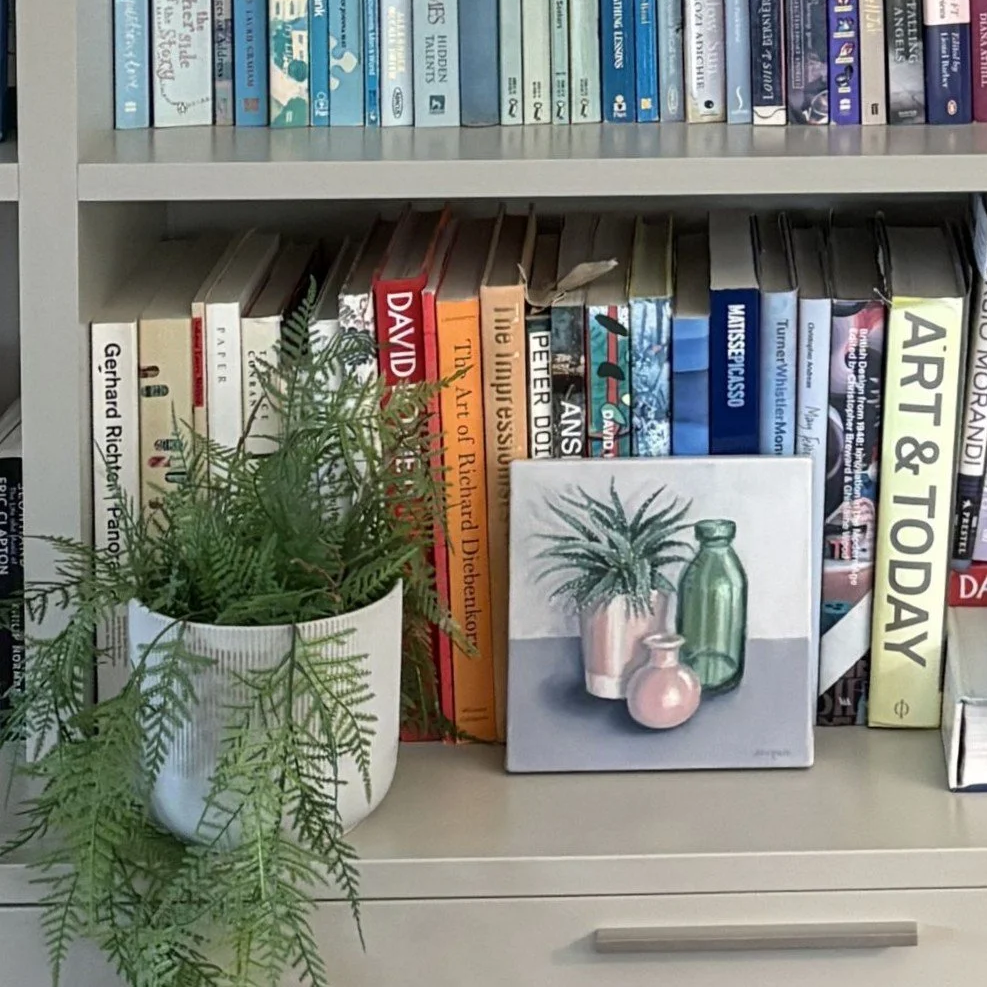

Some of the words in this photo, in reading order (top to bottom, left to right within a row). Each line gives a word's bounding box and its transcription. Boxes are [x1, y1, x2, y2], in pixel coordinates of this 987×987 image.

[425, 35, 435, 84] TALENTS
[437, 35, 448, 83] HIDDEN
[613, 32, 624, 69] LESSONS
[695, 33, 704, 89] ADICHIE
[386, 291, 417, 377] DAVID
[103, 342, 121, 419] Gerhard
[532, 335, 551, 407] PETER
[897, 312, 949, 429] ART
[104, 426, 122, 485] Richter
[893, 436, 940, 476] &
[884, 485, 937, 668] TODAY
